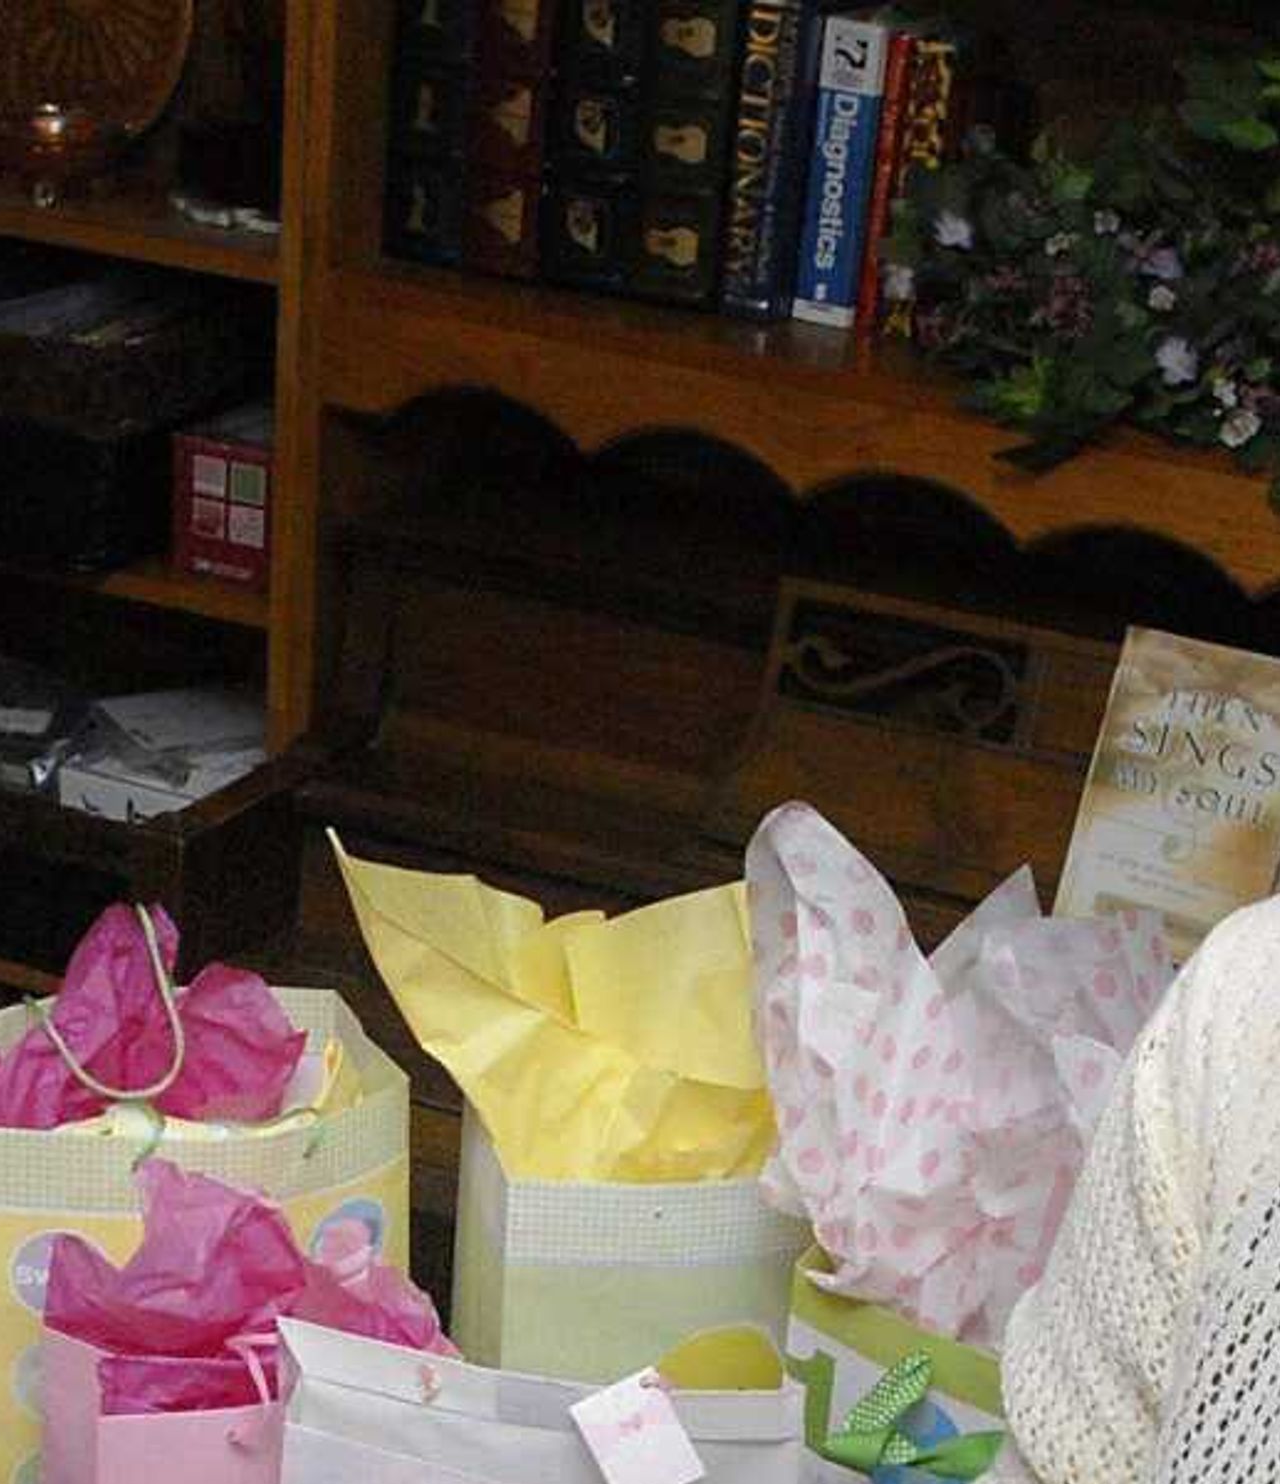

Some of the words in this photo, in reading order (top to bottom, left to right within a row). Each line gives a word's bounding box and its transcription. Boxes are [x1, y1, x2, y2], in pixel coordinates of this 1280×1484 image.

[721, 9, 781, 277] DICTIONARY
[815, 94, 859, 269] Diagnostics
[1131, 716, 1277, 787] SINGS
